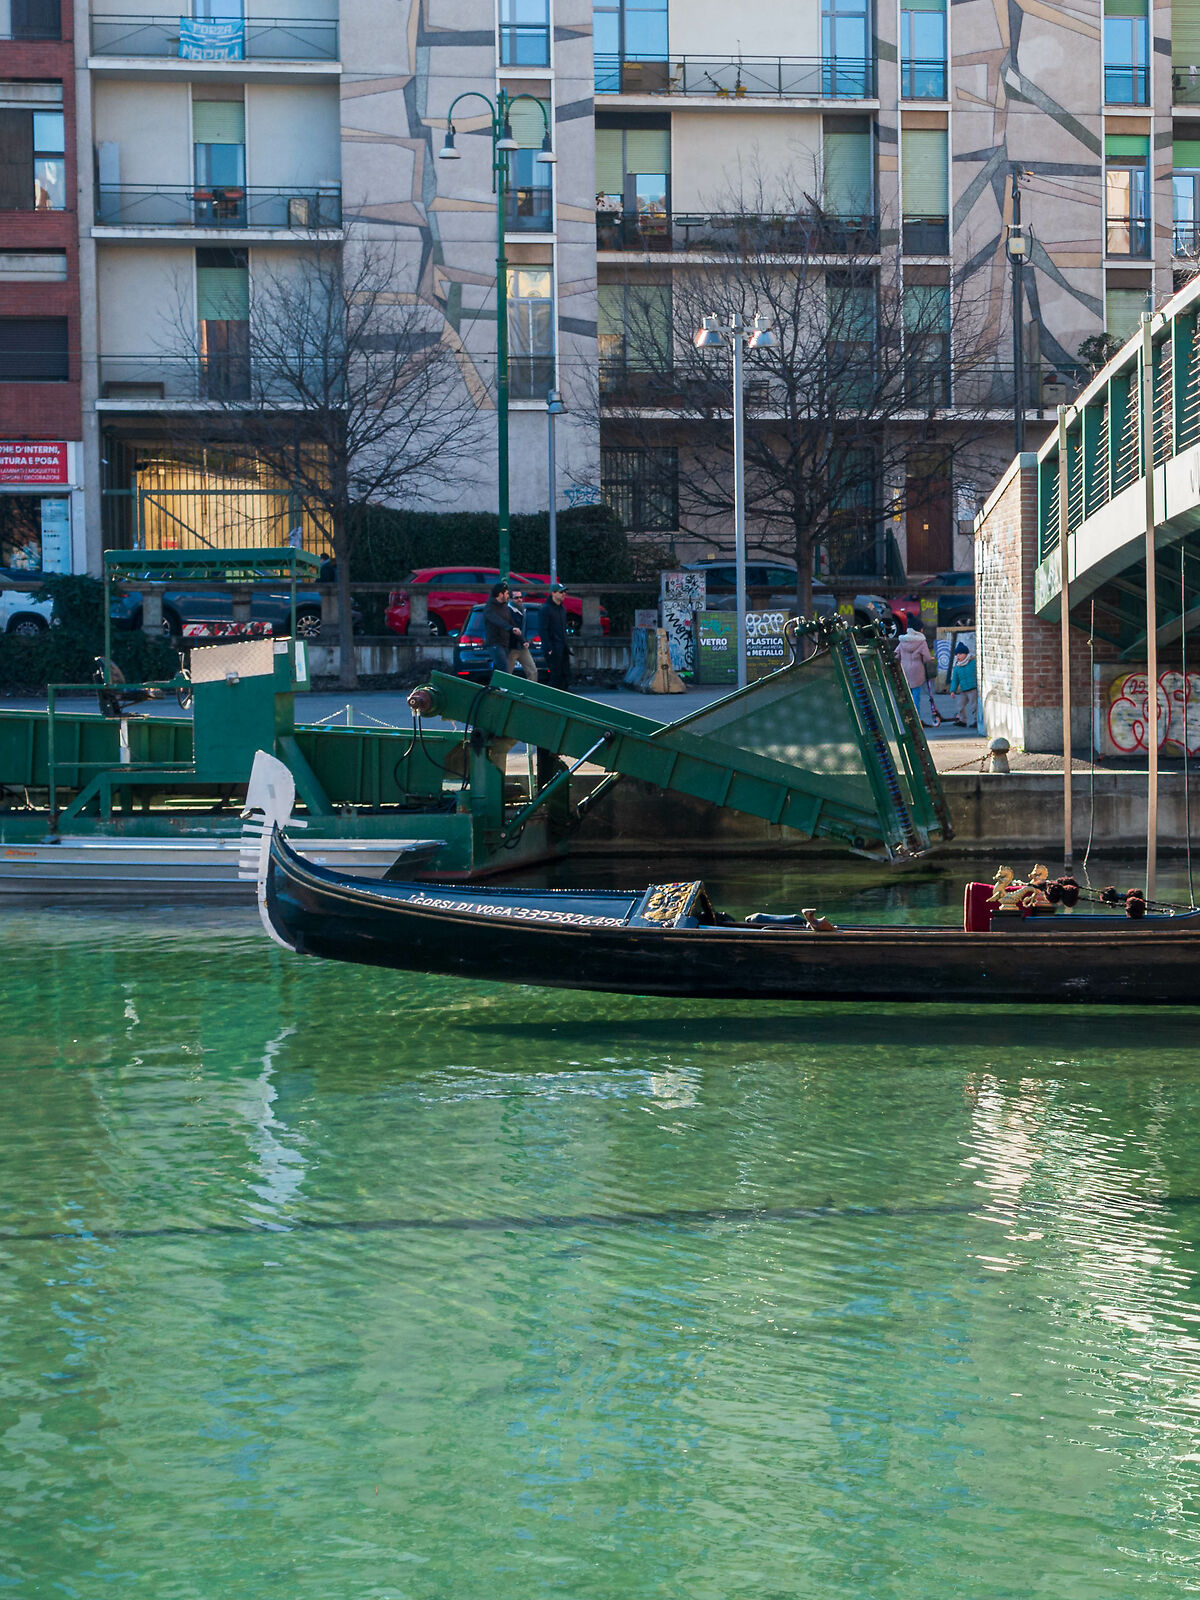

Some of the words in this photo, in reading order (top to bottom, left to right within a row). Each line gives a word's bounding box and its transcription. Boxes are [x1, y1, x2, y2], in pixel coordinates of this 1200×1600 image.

[193, 23, 232, 35] FORZA
[182, 44, 239, 60] NAPOLI
[15, 445, 60, 455] D'INTERNI,
[28, 457, 34, 465] E
[35, 457, 59, 465] POSA
[700, 638, 728, 646] VETRO
[414, 897, 456, 910] CORSI
[476, 904, 512, 916] VOGA
